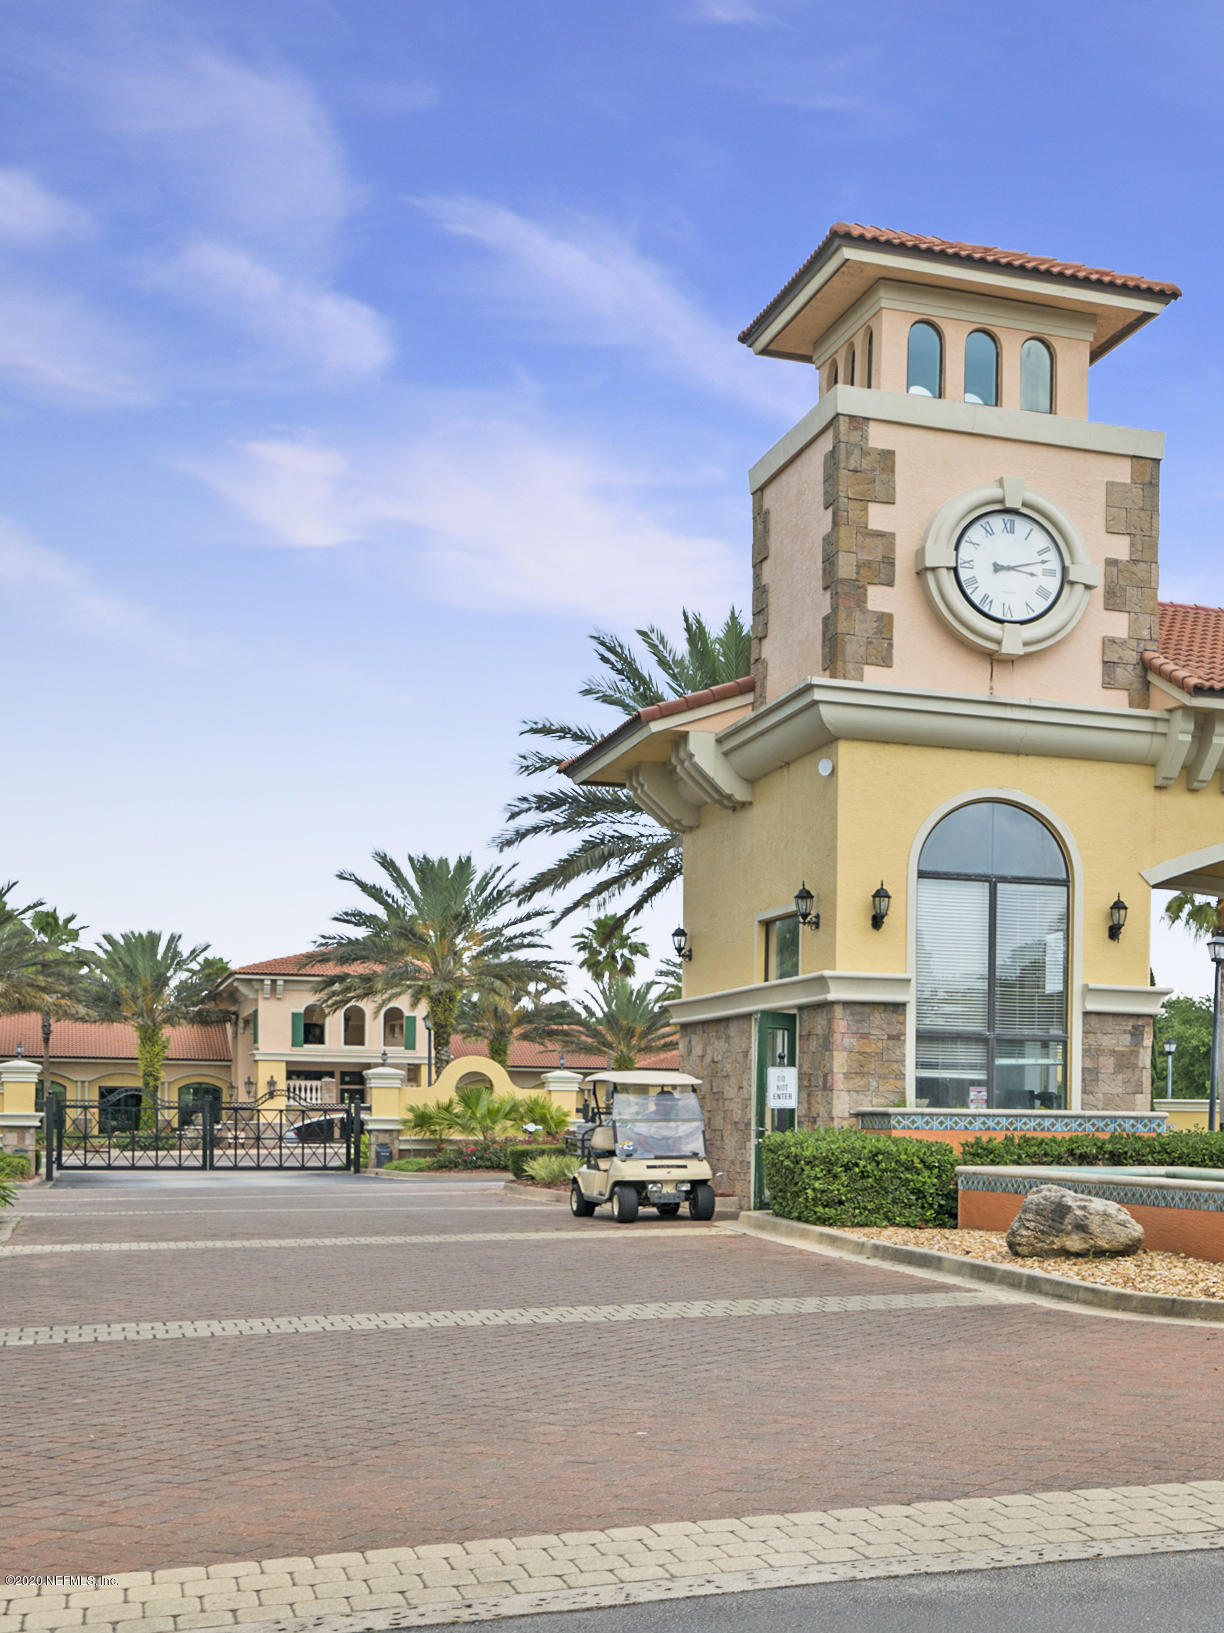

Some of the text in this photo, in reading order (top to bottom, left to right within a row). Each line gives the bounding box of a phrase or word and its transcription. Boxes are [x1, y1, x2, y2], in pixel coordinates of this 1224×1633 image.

[980, 520, 995, 538] XI
[1002, 518, 1015, 534] XII
[965, 536, 980, 550] X
[1036, 546, 1051, 556] II
[960, 558, 974, 569] IX
[1042, 568, 1056, 577] III
[963, 576, 980, 595] VIII
[1035, 585, 1053, 601] IIII
[979, 593, 994, 612] VII
[1002, 602, 1014, 618] VI
[1025, 601, 1036, 615] V
